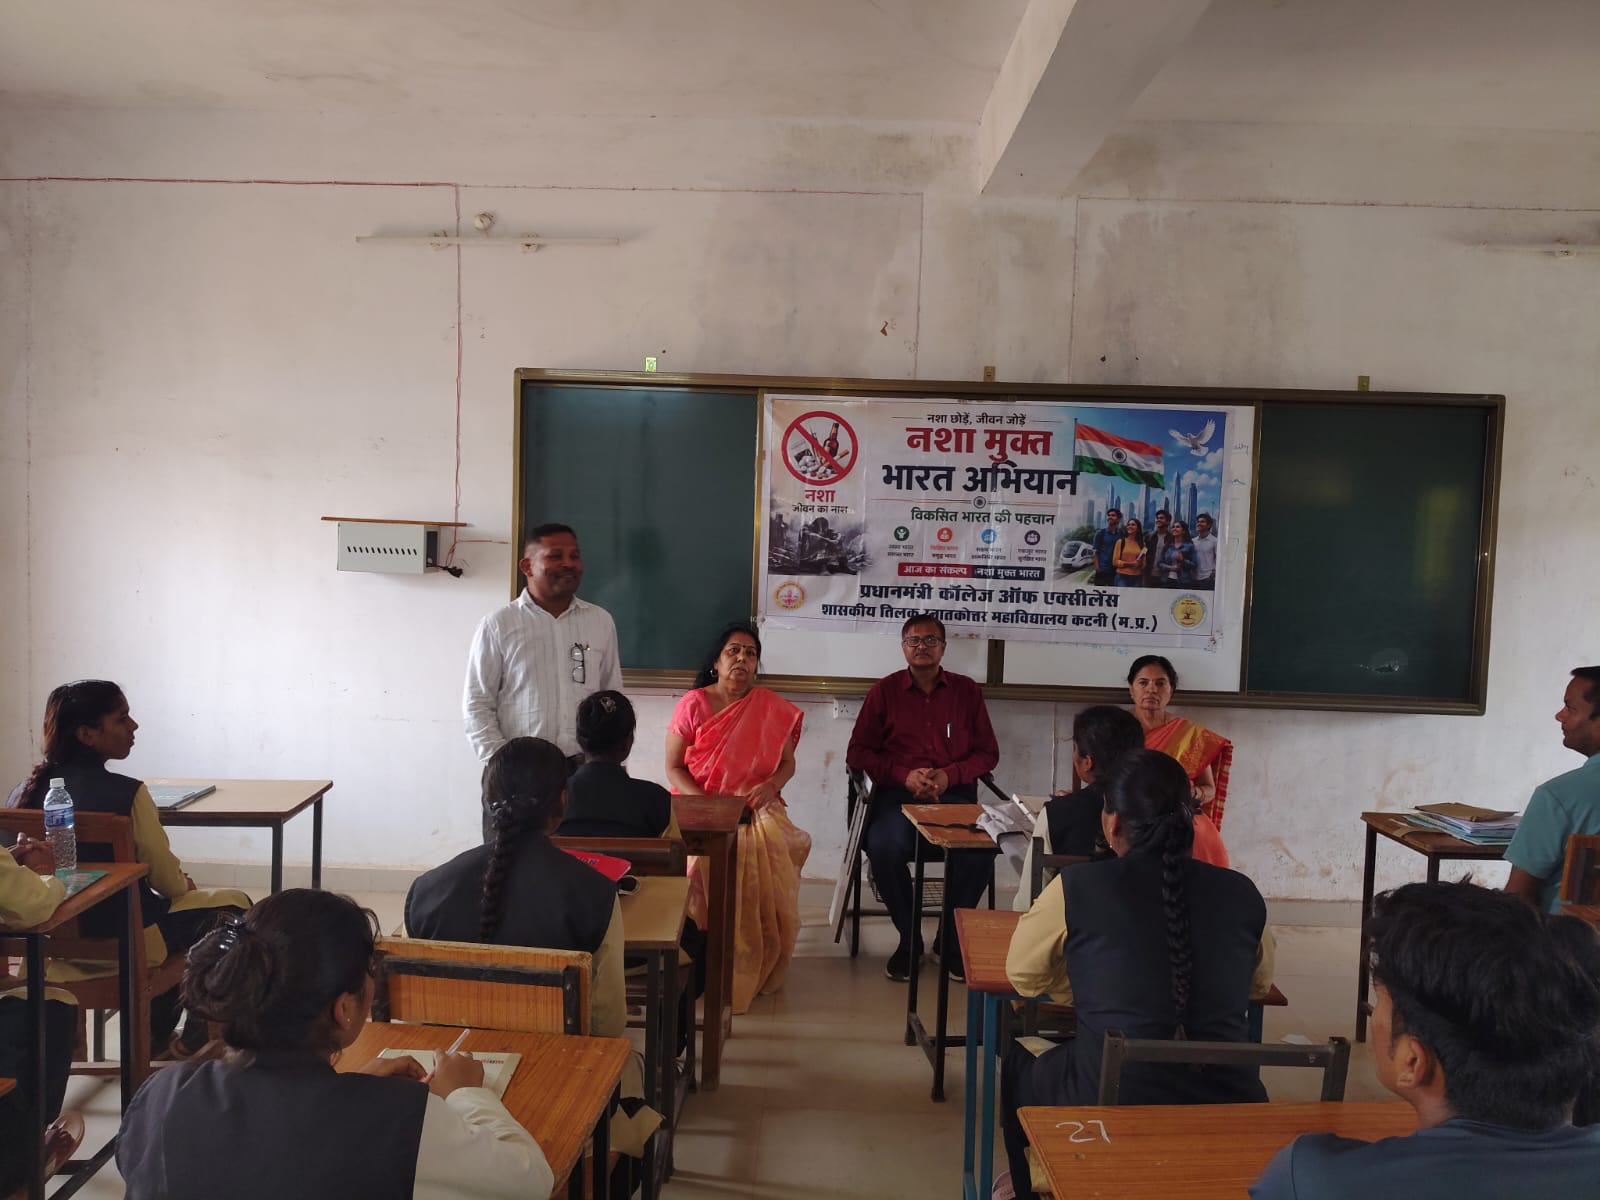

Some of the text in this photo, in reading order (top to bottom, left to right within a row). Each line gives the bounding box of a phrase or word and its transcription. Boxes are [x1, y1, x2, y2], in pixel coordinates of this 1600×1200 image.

[927, 414, 947, 423] नशा
[976, 414, 1003, 425] जीवन
[1006, 413, 1027, 427] जोड़ें
[906, 427, 1054, 462] नशा मुक्त
[882, 460, 1080, 496] भारत अभियान
[804, 489, 836, 503] नशा
[792, 502, 815, 513] जीवन
[816, 504, 829, 513] का
[910, 506, 1056, 526] विकसित भारत की पहचान
[903, 564, 1040, 578] आज का संकल्प नशा मुक्त भारत
[859, 583, 1120, 608] प्रधानमंत्री कॉलेज ऑफ एक्सीलेंस
[822, 603, 876, 618] शासकीय
[880, 603, 920, 618] तिलक
[990, 608, 1068, 626] महाविद्यालय
[1071, 612, 1108, 628] कटनी
[1056, 1120, 1111, 1144] 27
